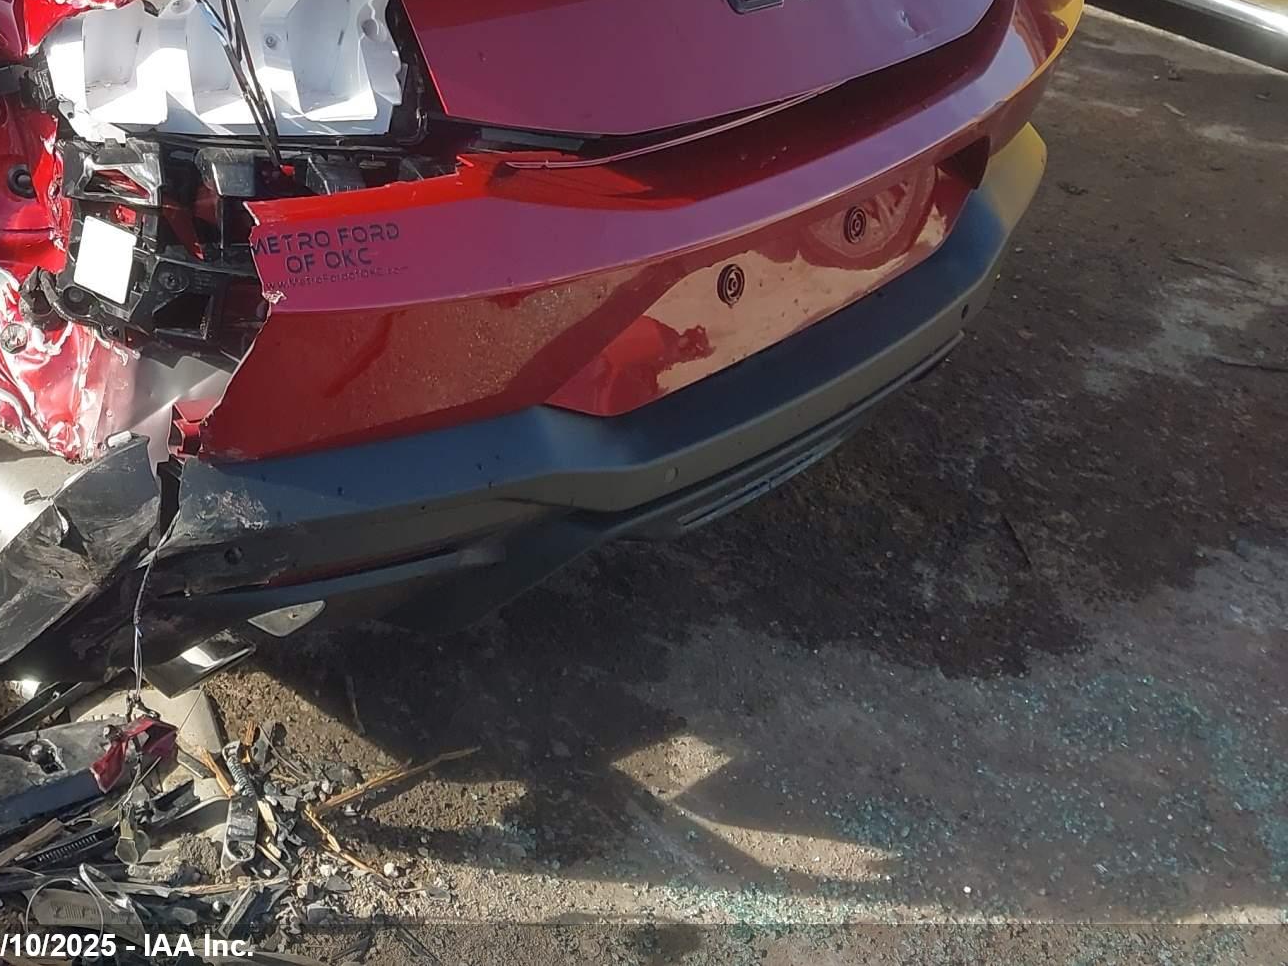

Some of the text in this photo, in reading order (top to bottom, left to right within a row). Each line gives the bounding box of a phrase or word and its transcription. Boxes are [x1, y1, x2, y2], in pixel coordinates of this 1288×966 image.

[252, 223, 400, 256] METRO FORD
[286, 247, 372, 274] OF OKC
